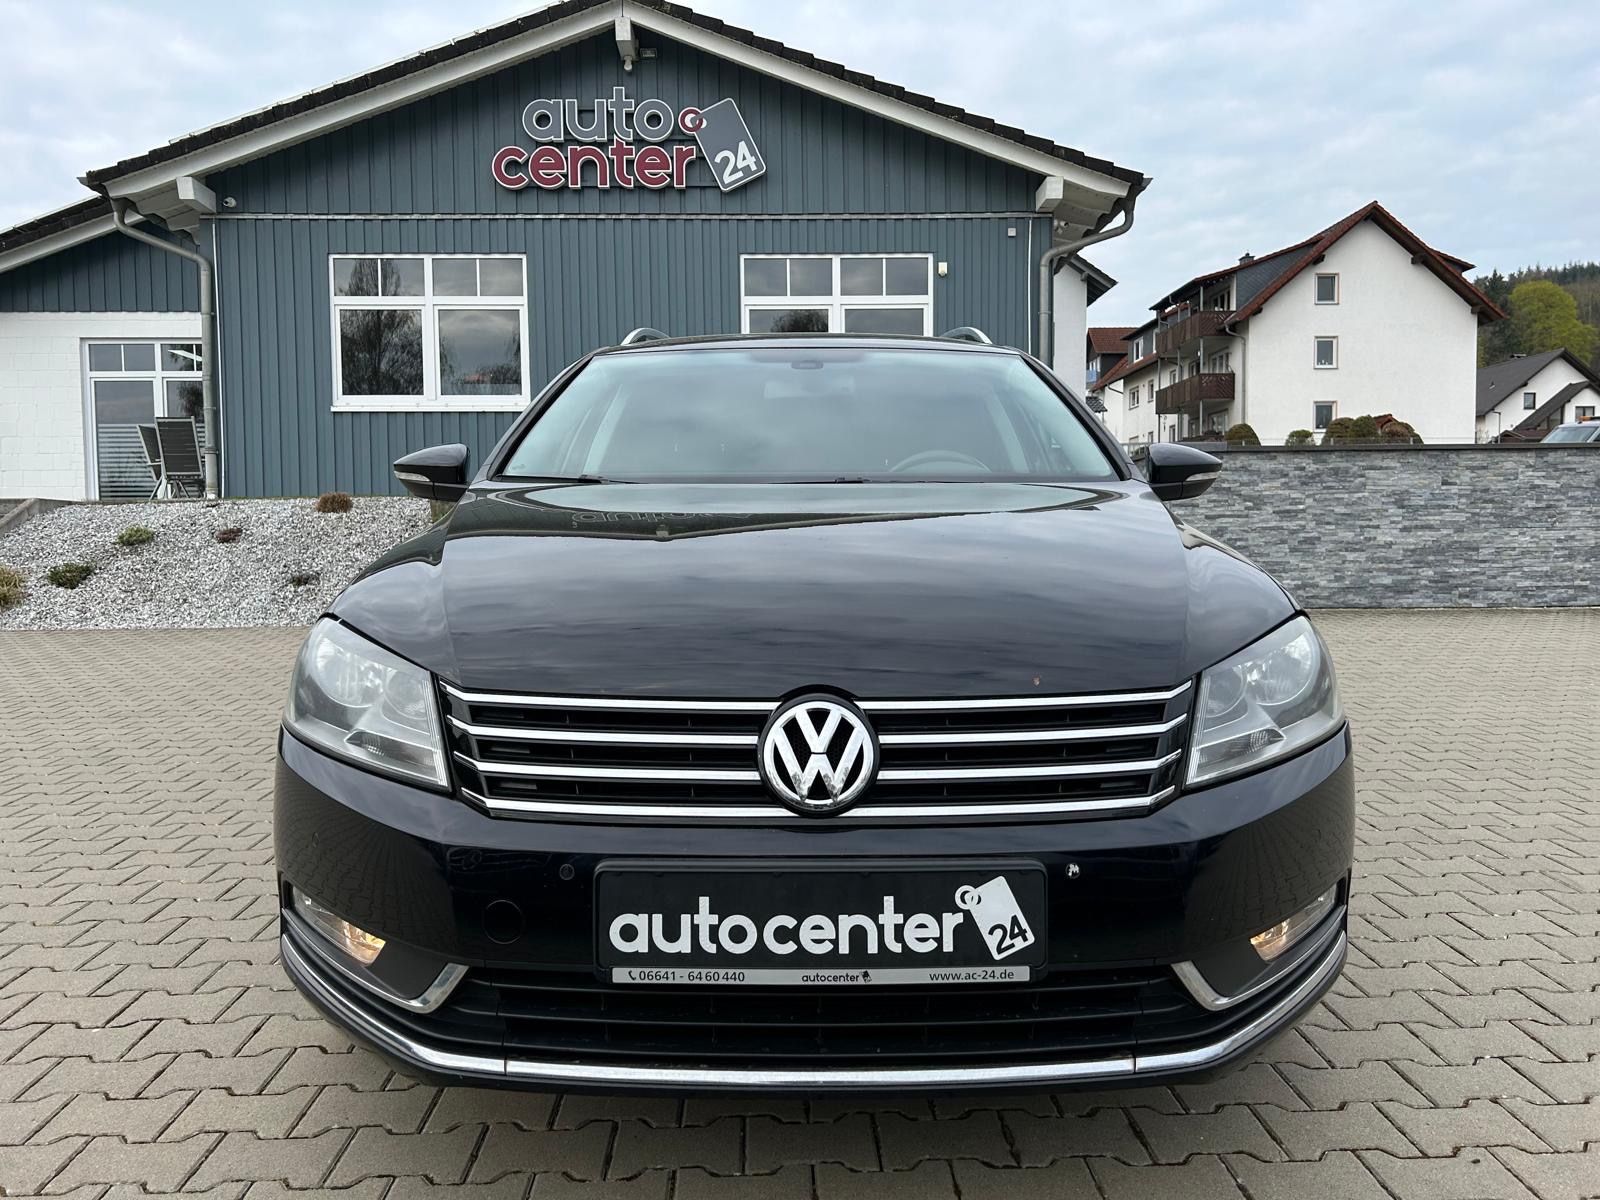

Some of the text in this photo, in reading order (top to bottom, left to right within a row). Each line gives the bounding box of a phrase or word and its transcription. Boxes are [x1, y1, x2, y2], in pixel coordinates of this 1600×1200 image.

[522, 87, 674, 142] auto
[492, 133, 697, 189] center
[714, 140, 757, 184] 24
[988, 914, 1029, 956] 24
[638, 970, 676, 982] 06641
[801, 972, 860, 983] autocenter
[929, 970, 1015, 982] www.ac-24.de
